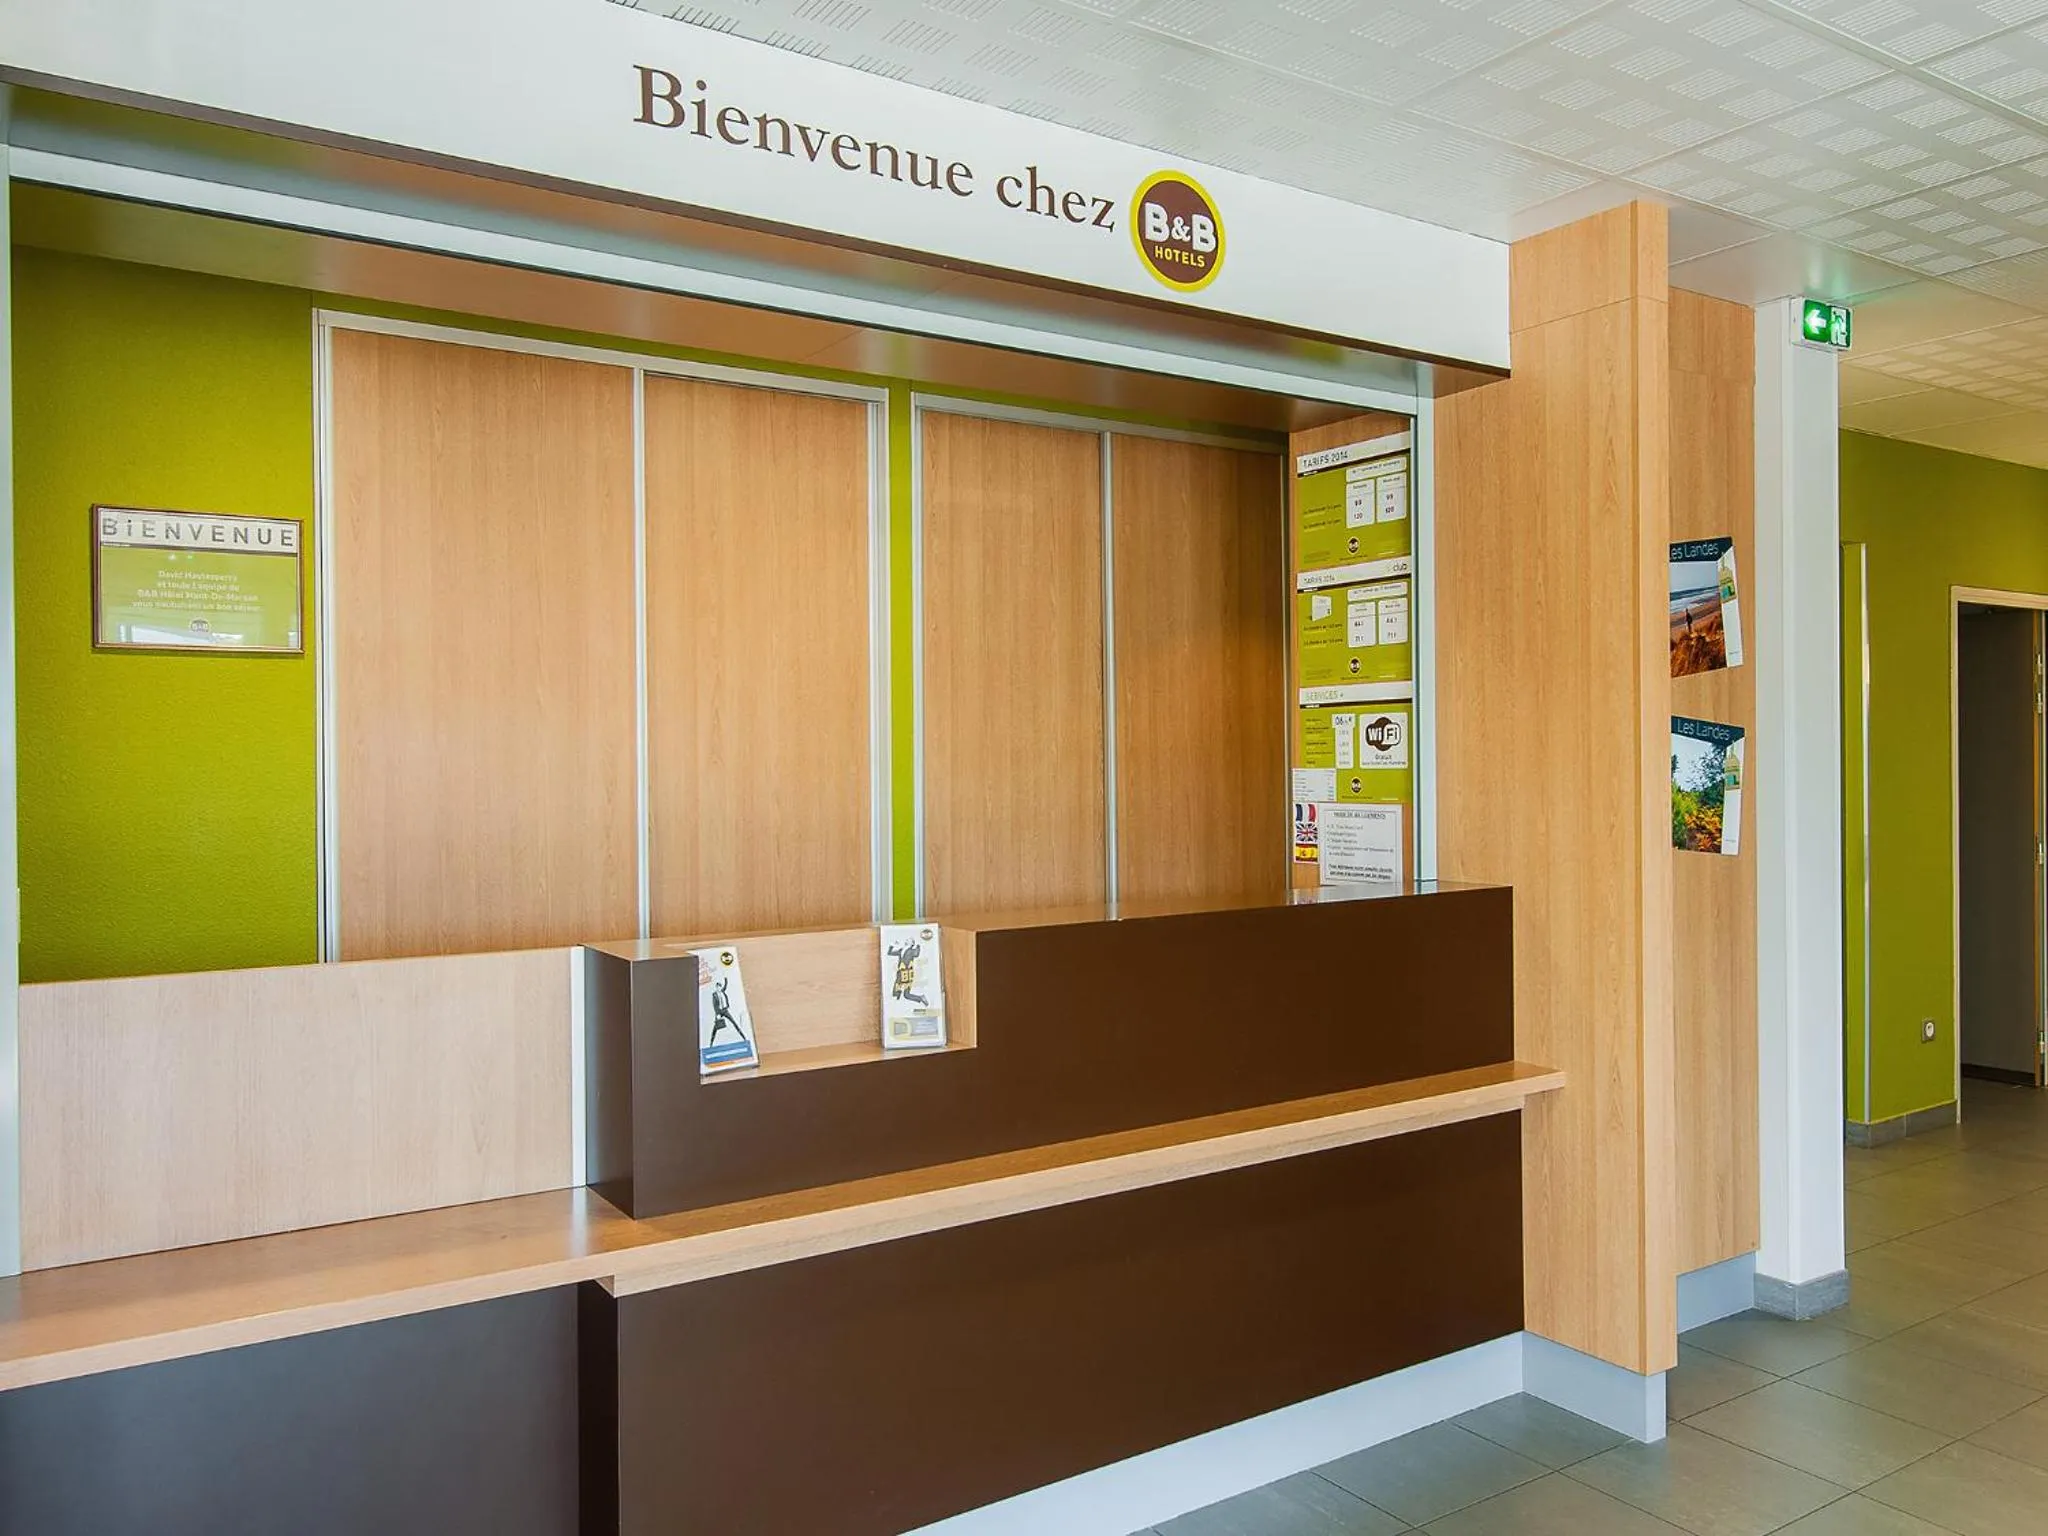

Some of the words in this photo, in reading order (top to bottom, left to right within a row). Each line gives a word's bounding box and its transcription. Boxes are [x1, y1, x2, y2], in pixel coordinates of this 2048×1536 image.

[632, 64, 974, 198] Bienvenue
[995, 166, 1117, 233] chez
[1144, 201, 1216, 253] B&B
[1154, 245, 1206, 268] HOTELS
[1303, 454, 1329, 468] TARIFS
[1684, 542, 1719, 559] Landes
[1677, 718, 1694, 735] Les
[1696, 723, 1730, 741] Landes
